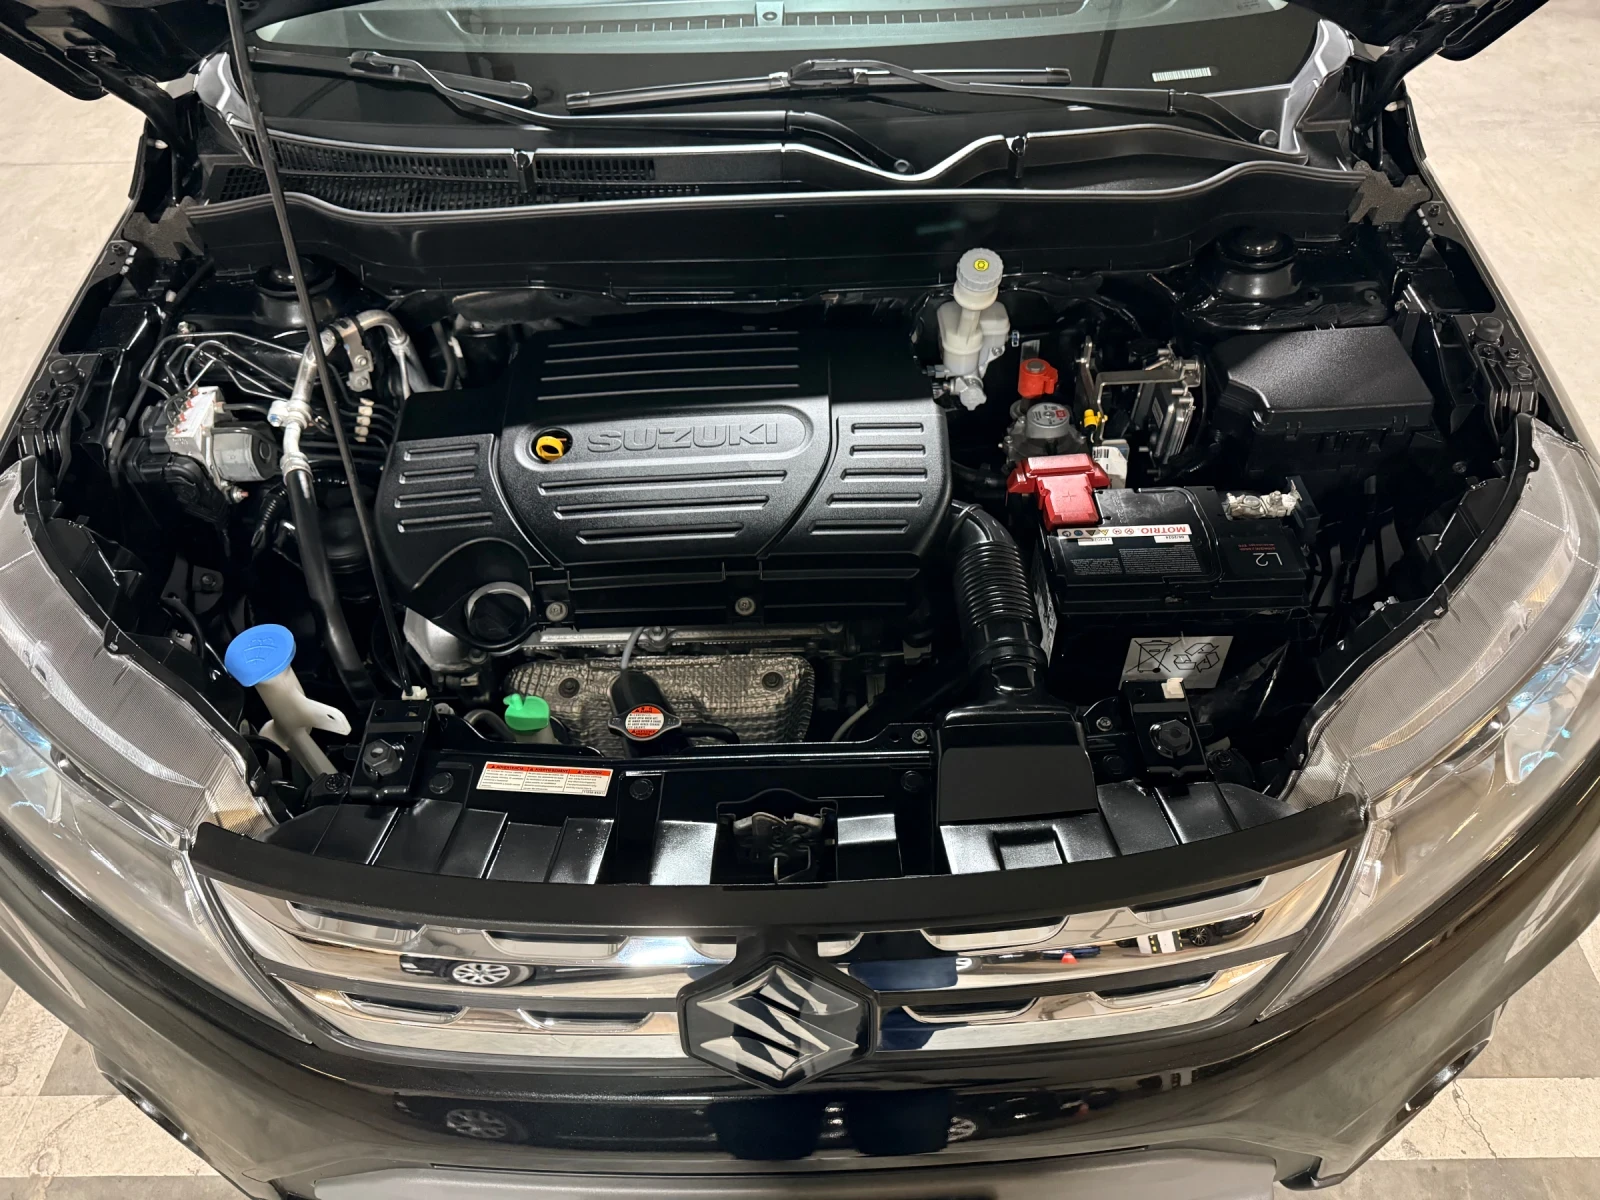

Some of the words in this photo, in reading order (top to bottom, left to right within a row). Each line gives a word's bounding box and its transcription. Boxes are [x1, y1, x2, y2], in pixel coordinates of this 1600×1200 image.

[587, 423, 778, 452] SUZUKI
[1141, 526, 1186, 534] MOTRIO
[1253, 552, 1283, 566] L2
